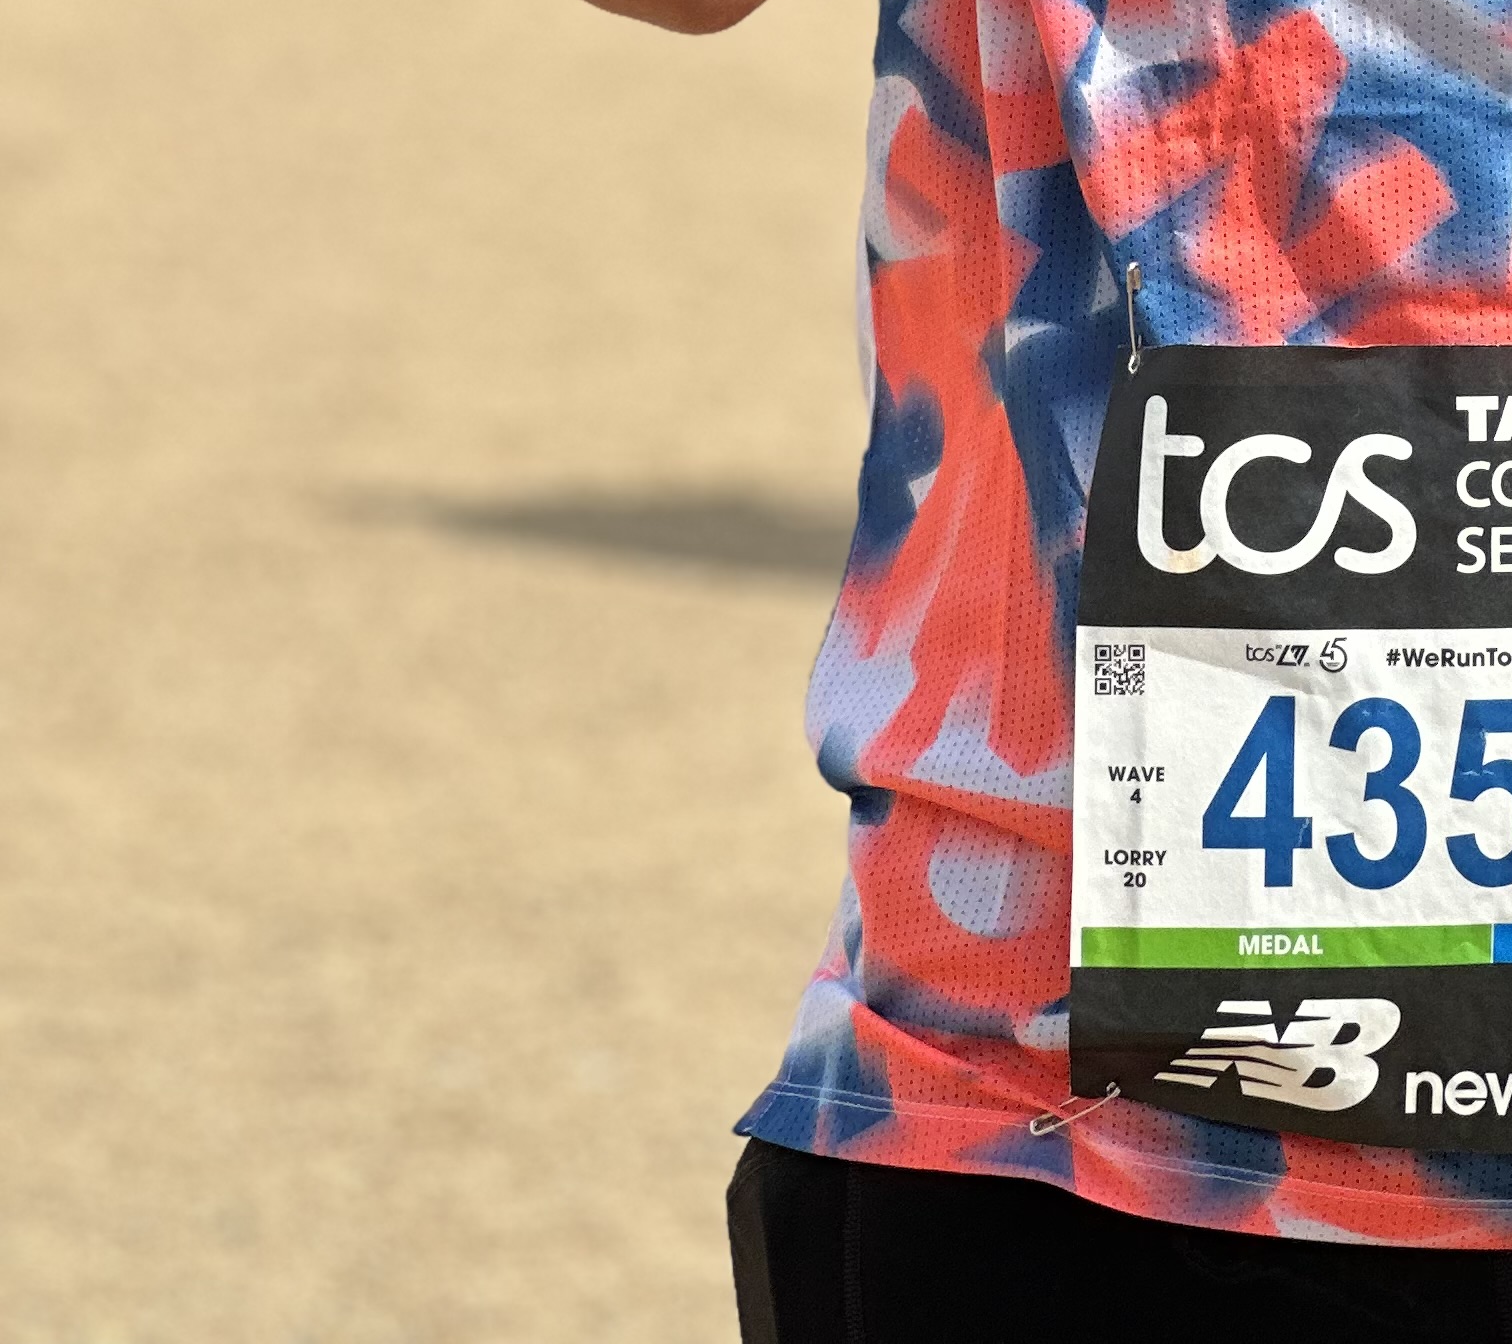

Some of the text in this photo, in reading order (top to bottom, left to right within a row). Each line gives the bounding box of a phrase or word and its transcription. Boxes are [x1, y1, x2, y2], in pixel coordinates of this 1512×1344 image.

[1136, 394, 1417, 576] tcs
[1246, 643, 1275, 662] tcs
[1107, 766, 1166, 783] WAVE
[1129, 788, 1143, 804] 4
[1103, 850, 1168, 867] LORRY
[1122, 872, 1148, 888] 20
[1238, 934, 1324, 956] MEDAL
